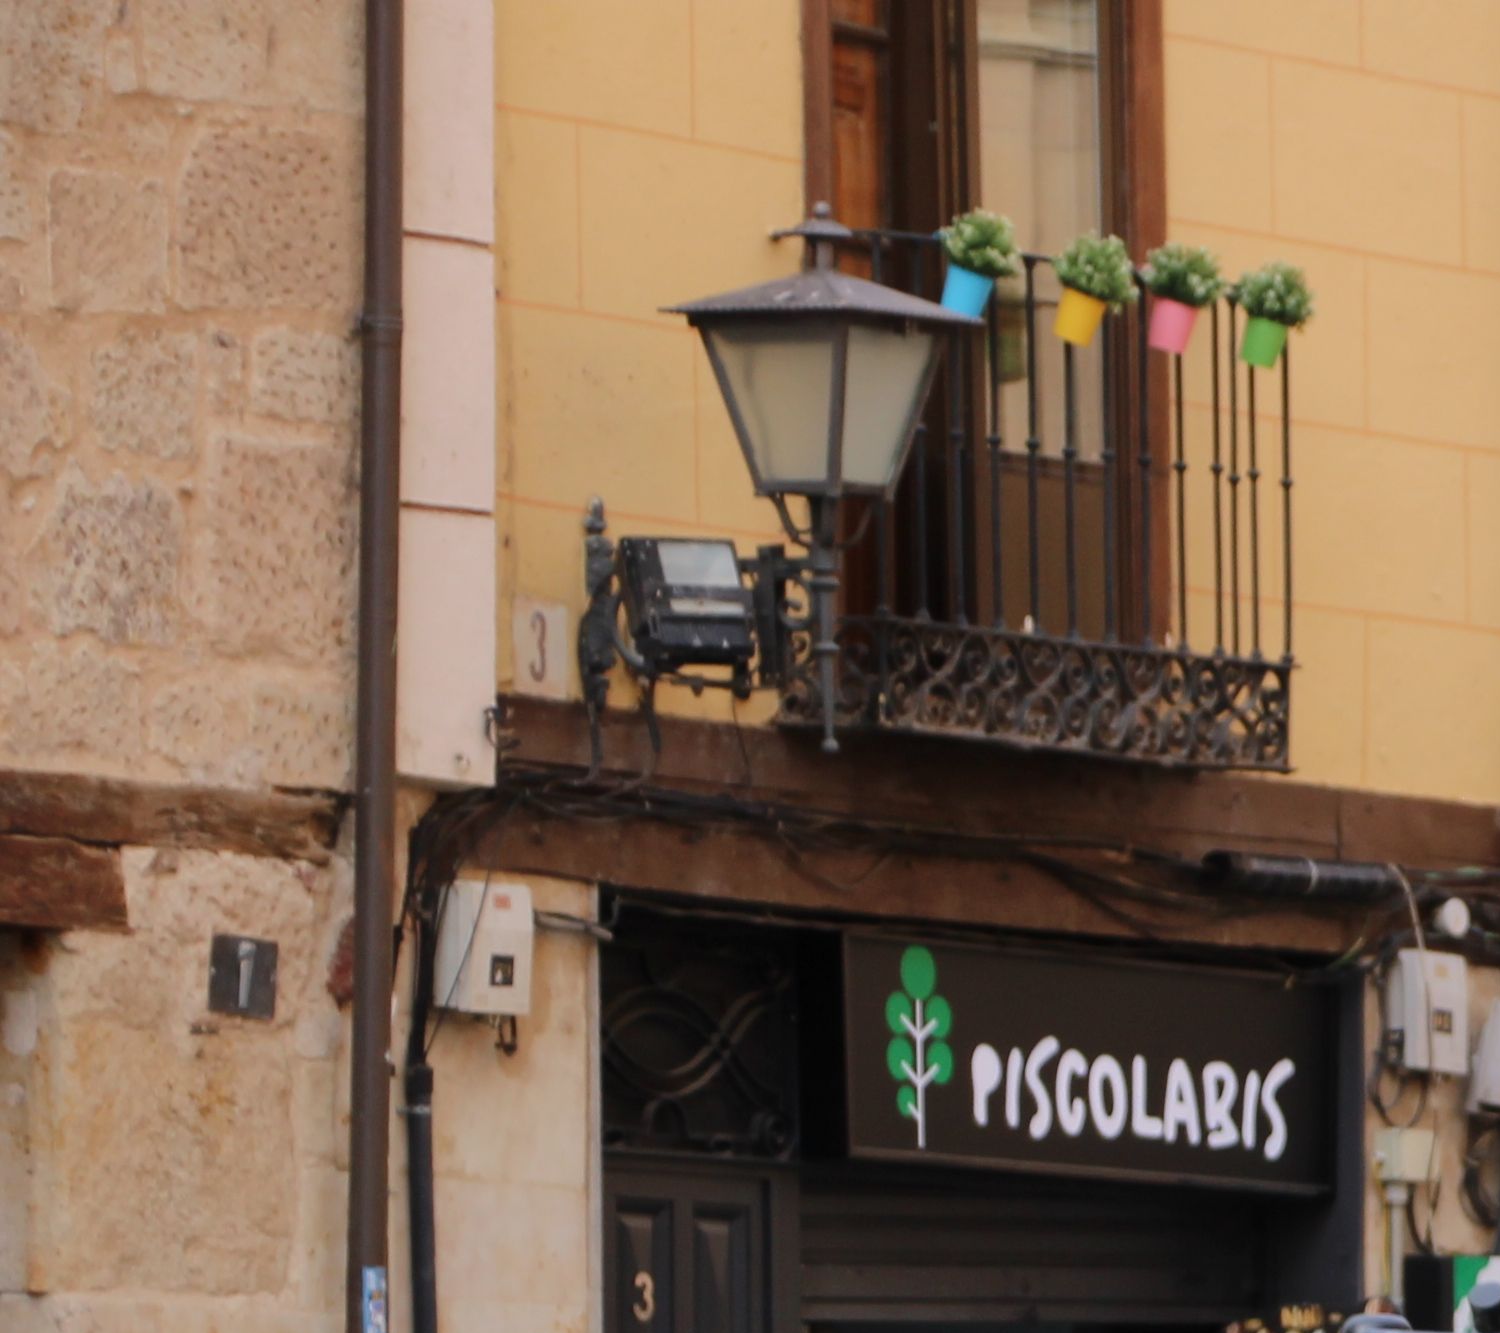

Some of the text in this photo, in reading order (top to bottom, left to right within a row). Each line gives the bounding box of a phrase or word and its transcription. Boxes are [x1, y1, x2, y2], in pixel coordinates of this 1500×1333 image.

[528, 610, 547, 684] 3
[971, 1035, 1297, 1162] PISCOLABIS
[632, 1271, 655, 1323] 3
